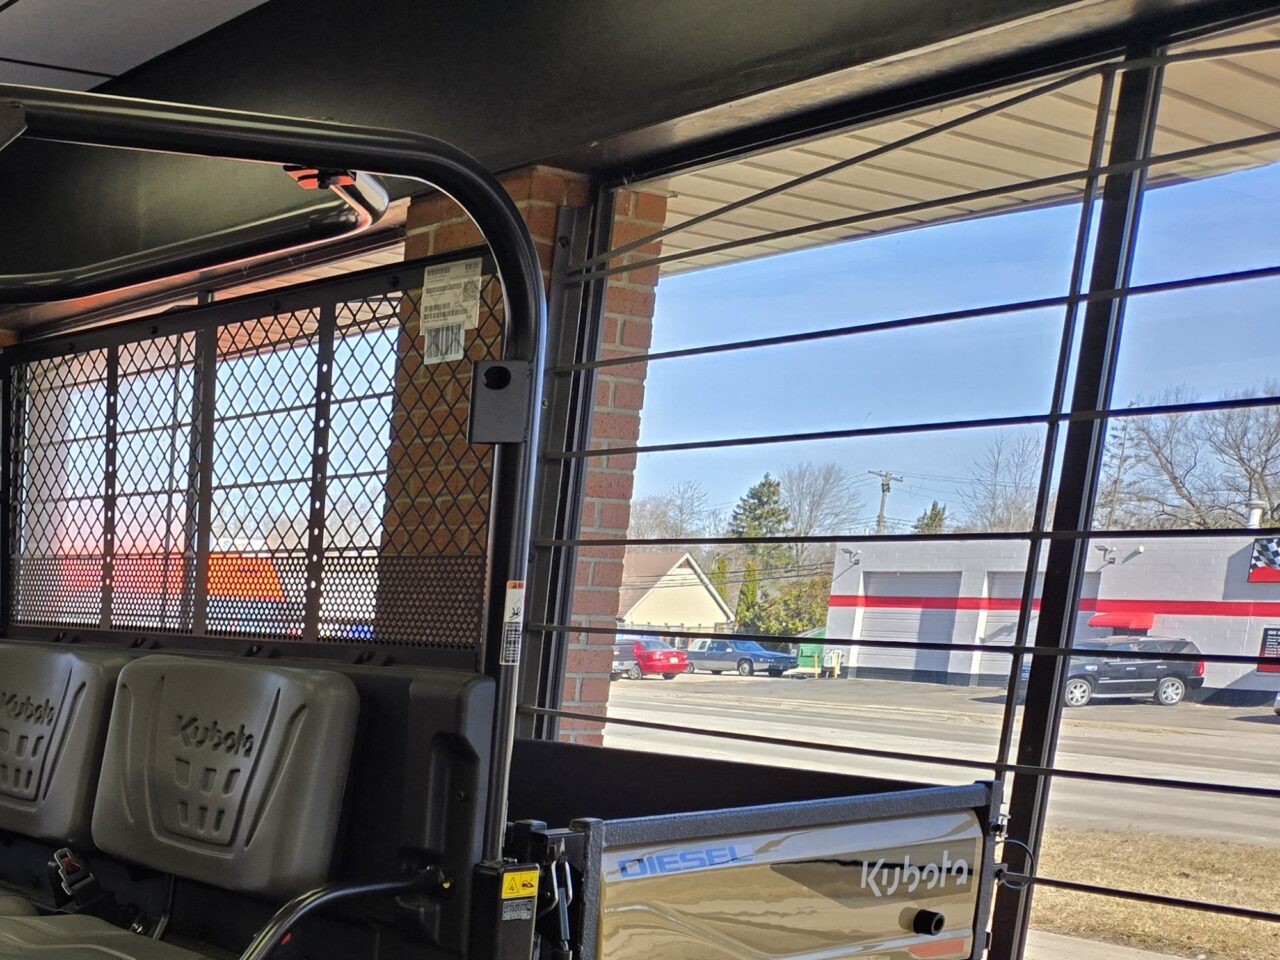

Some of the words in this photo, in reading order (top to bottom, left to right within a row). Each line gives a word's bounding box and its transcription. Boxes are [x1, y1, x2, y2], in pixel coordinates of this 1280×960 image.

[1, 691, 56, 727] Kubota
[175, 713, 255, 757] Kubota
[618, 845, 756, 878] DIESEL
[860, 850, 969, 897] Kubota
